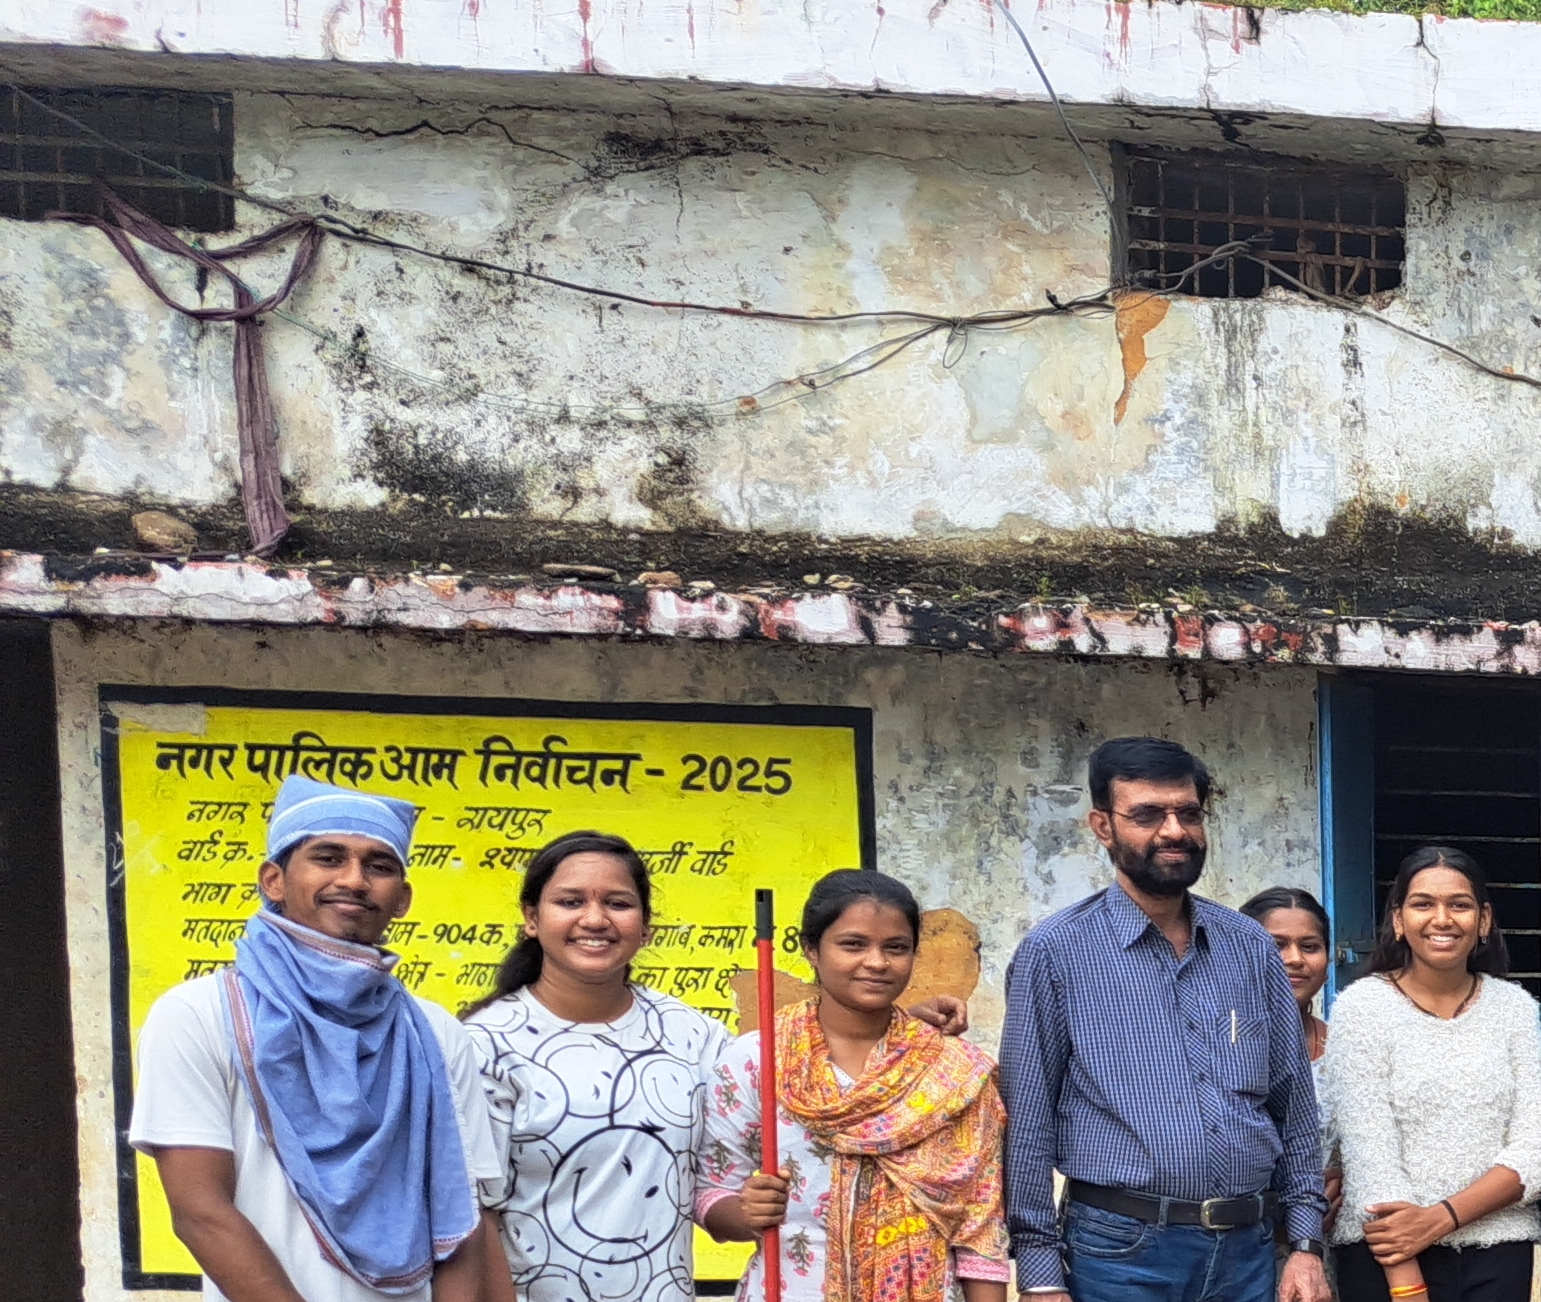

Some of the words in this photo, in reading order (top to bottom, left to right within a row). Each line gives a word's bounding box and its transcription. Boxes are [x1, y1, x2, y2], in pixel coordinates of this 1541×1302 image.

[155, 741, 239, 780] नगर
[244, 731, 377, 786] पालिक
[379, 745, 467, 790] आम
[473, 735, 643, 794] निर्वाचन
[680, 753, 793, 796] 2025
[186, 800, 250, 824] नगर
[456, 806, 552, 840] रायपुर
[177, 830, 223, 862] वार्ड
[689, 840, 735, 876] वार्ड
[181, 882, 237, 905] भाग
